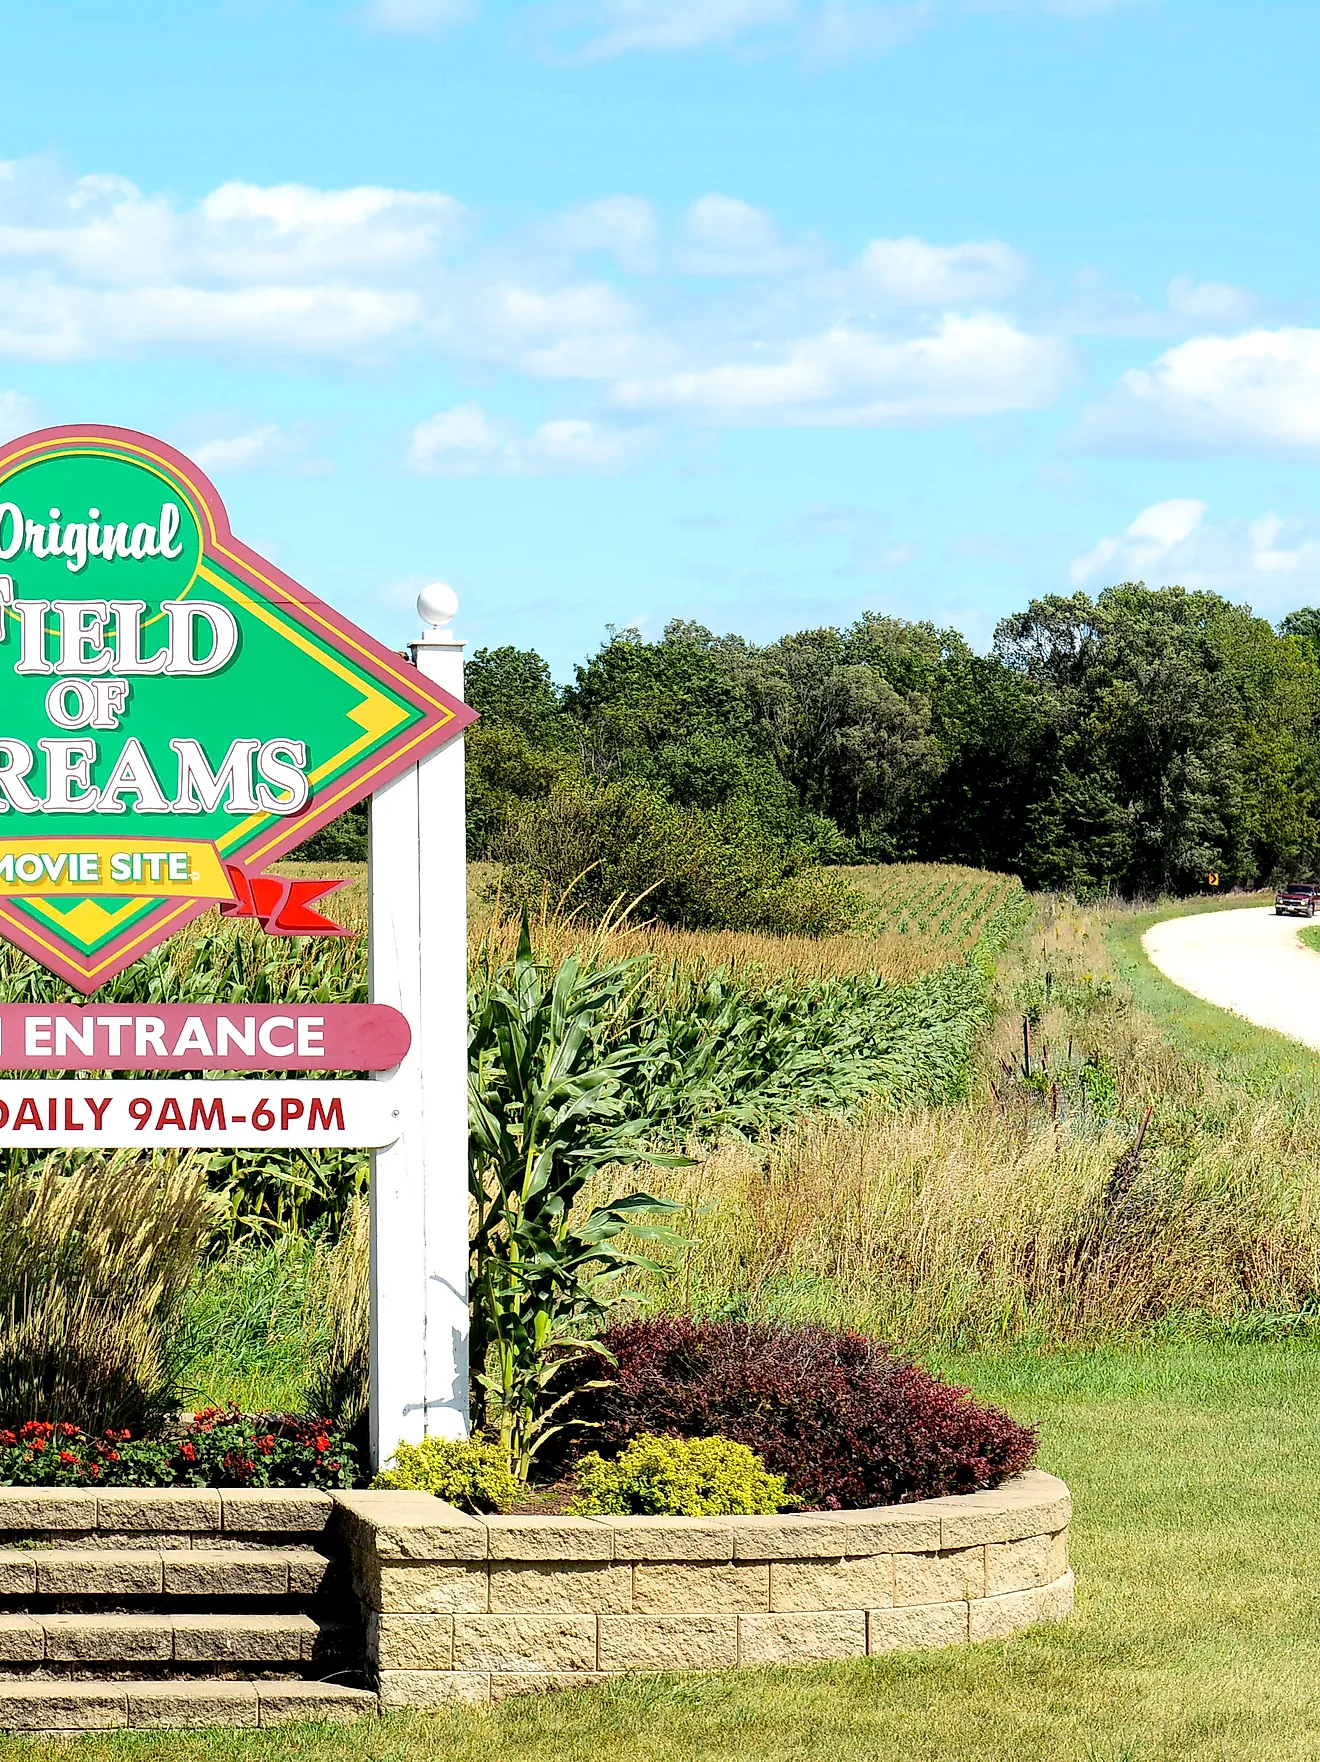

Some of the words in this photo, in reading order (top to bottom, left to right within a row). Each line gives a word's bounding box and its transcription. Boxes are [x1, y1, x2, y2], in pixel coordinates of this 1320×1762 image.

[45, 678, 128, 729] OF
[111, 852, 188, 881] SITE
[24, 1016, 325, 1057] ENTRANCE
[128, 1097, 346, 1132] 9AM-6PM
